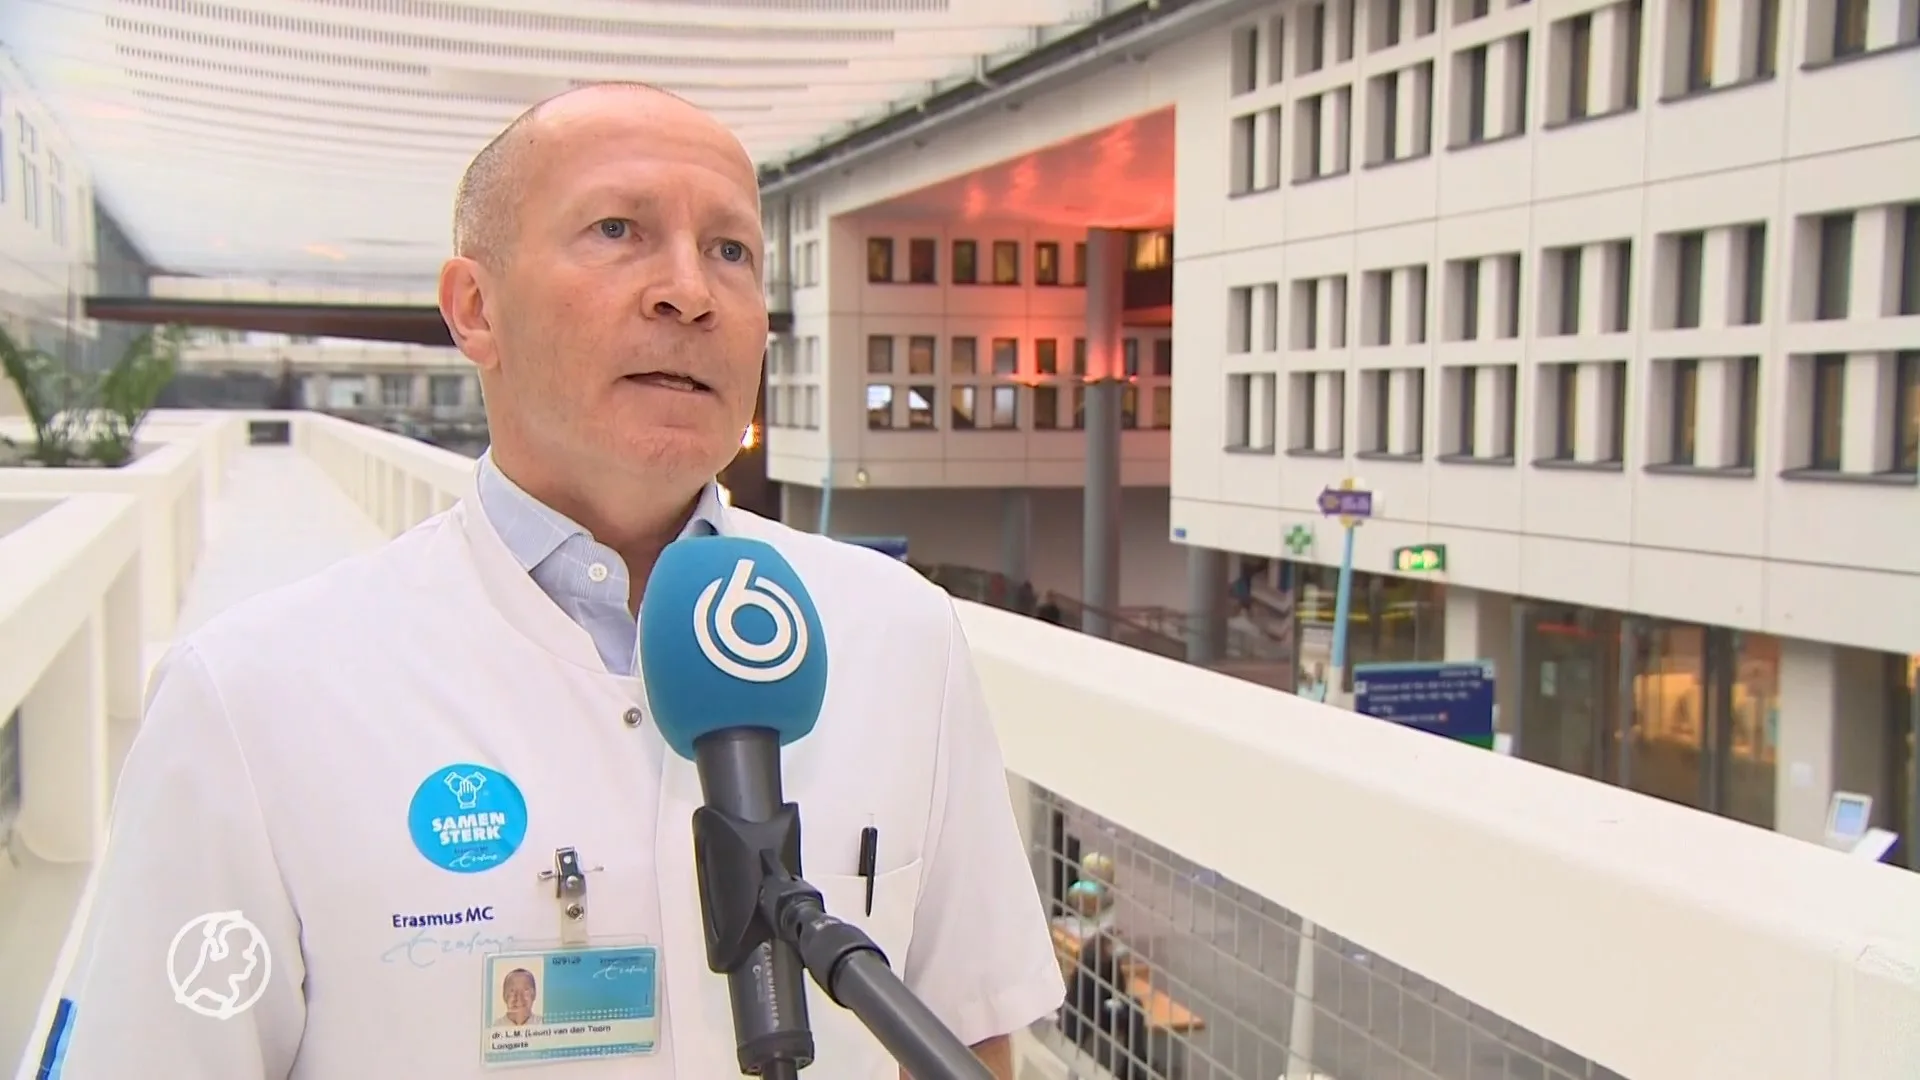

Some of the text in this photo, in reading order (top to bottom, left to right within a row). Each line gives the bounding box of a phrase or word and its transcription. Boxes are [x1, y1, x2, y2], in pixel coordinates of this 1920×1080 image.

[693, 558, 809, 683] 6
[431, 812, 505, 832] SAMEN
[440, 826, 501, 845] STERK
[392, 906, 494, 928] Erasmus MC
